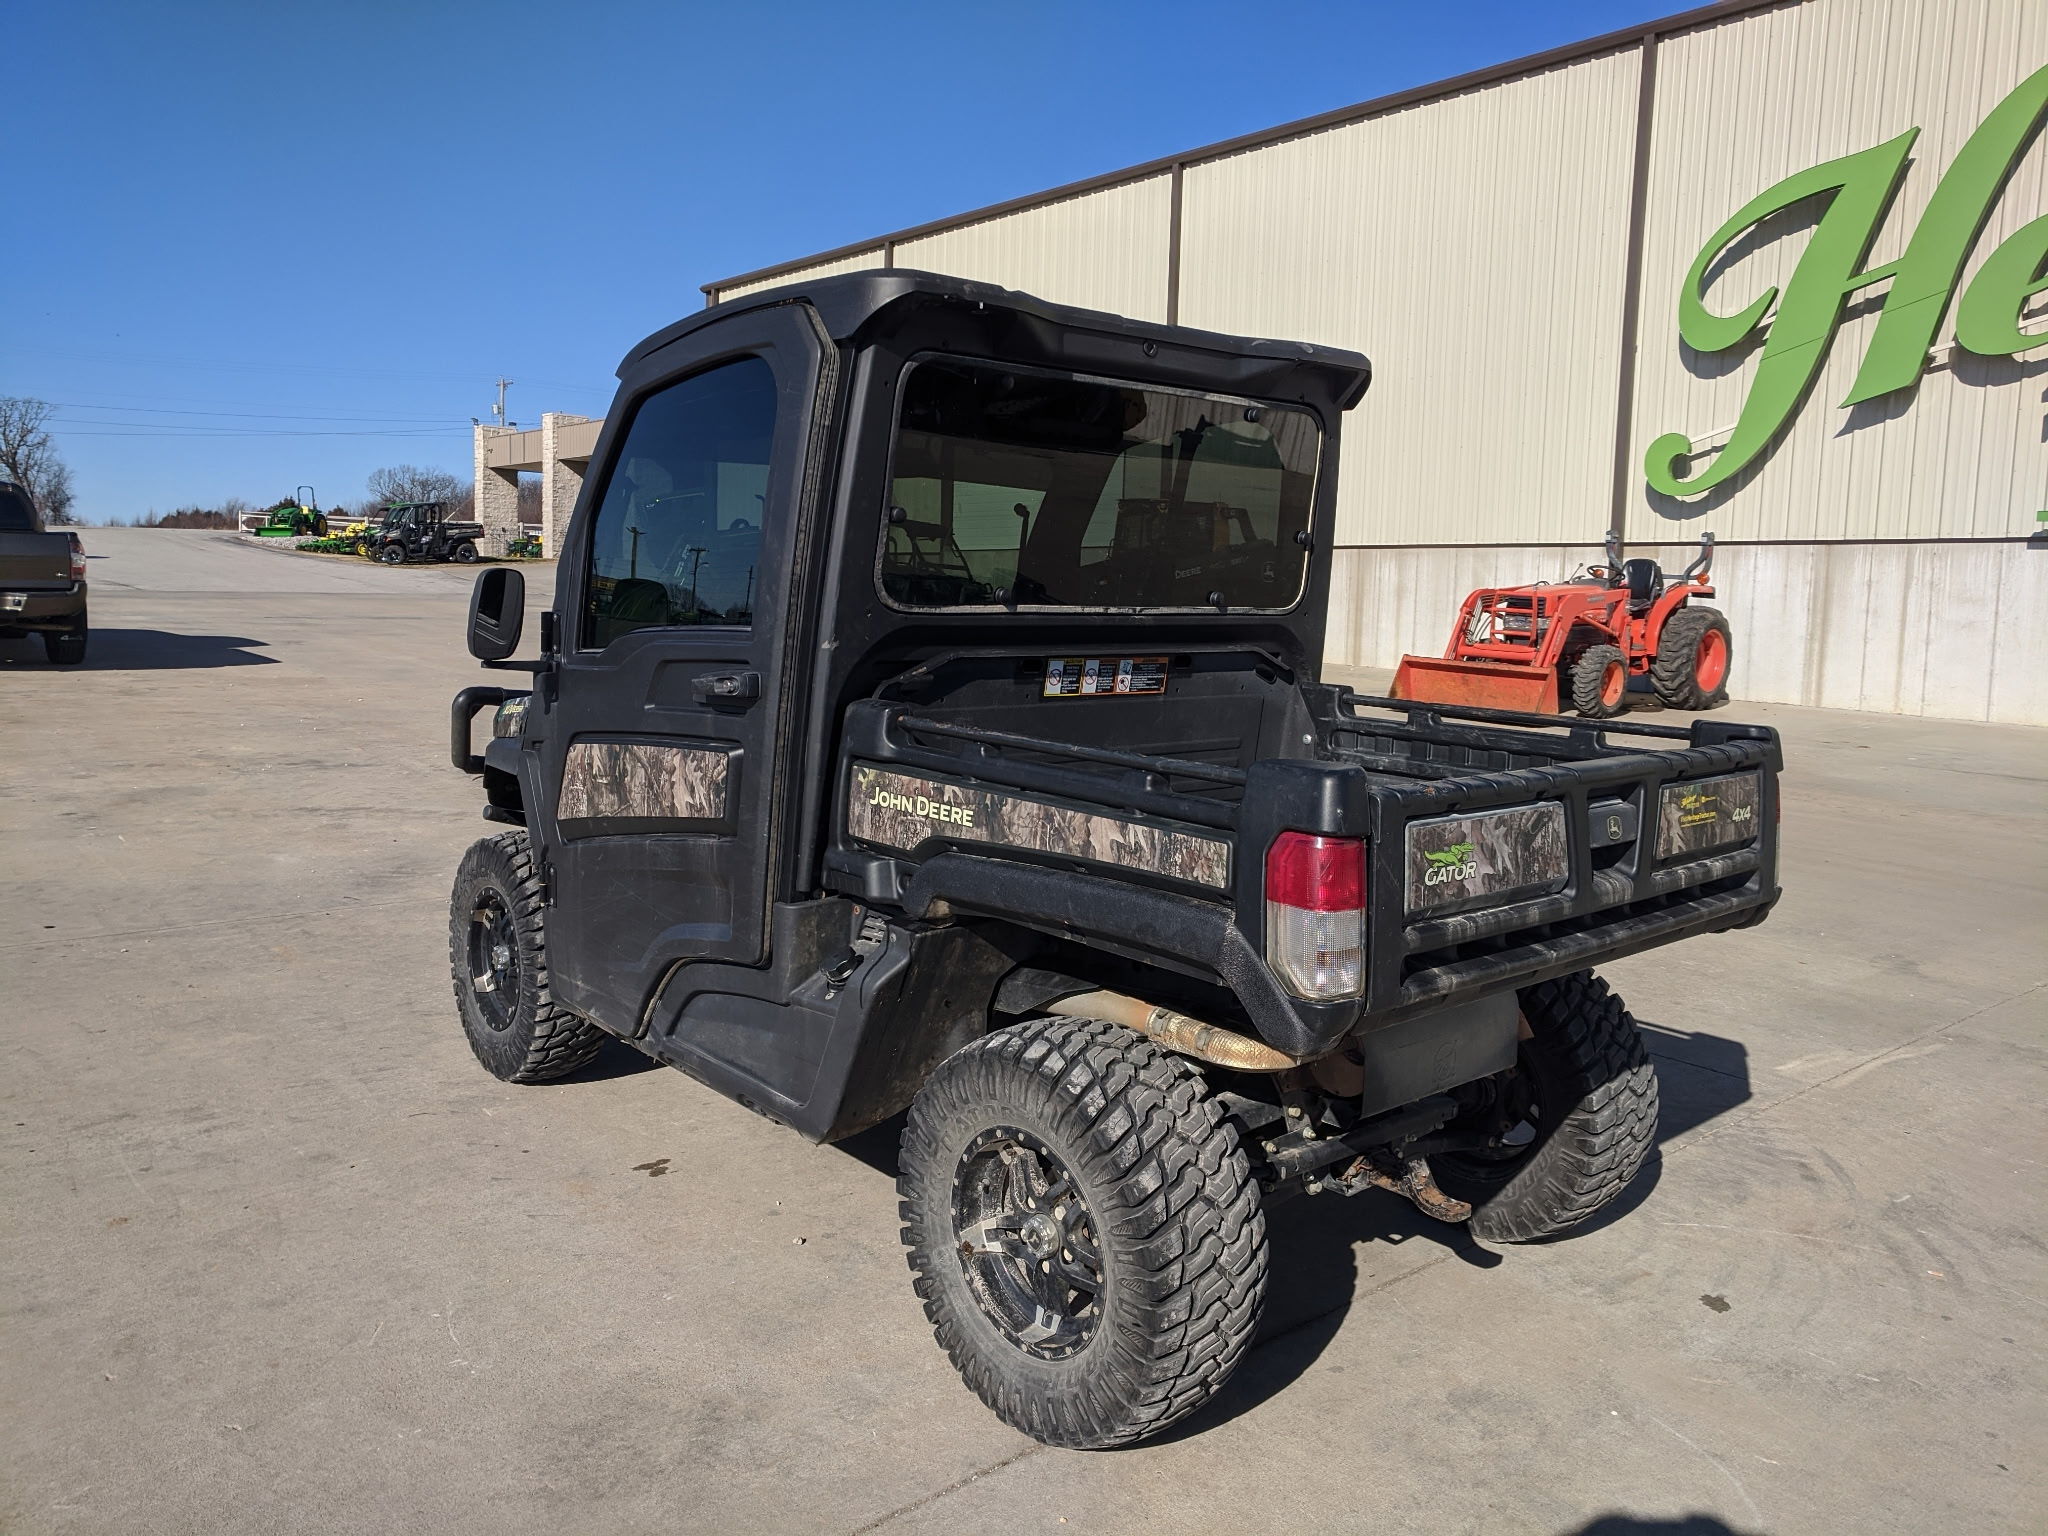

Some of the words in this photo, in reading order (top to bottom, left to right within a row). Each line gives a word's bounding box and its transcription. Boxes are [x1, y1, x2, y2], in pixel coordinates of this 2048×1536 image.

[1175, 566, 1202, 580] DEERE
[869, 786, 914, 814] JOHN
[916, 795, 974, 828] DEERE
[1424, 861, 1477, 886] GATOR
